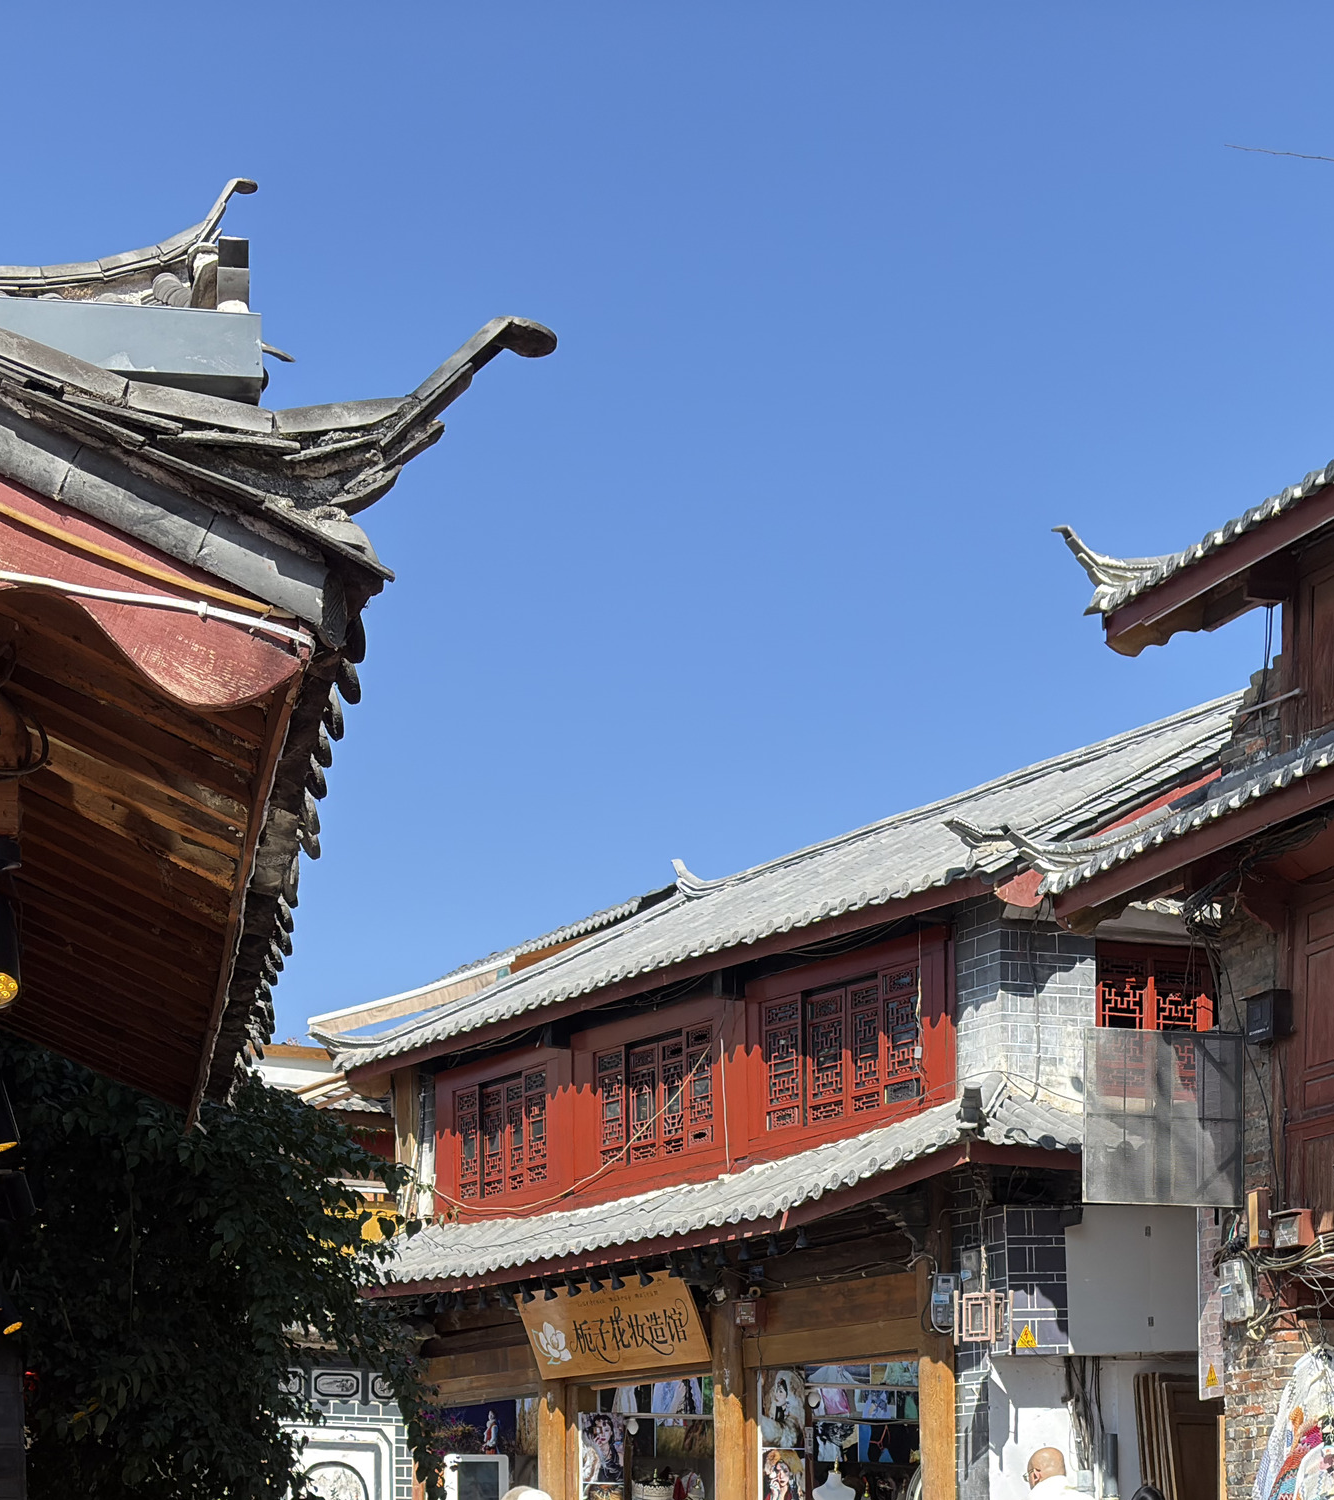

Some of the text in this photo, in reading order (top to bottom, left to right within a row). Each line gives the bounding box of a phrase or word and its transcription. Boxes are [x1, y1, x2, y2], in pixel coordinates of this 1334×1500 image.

[570, 1298, 689, 1364] 栀子花妆造馆
